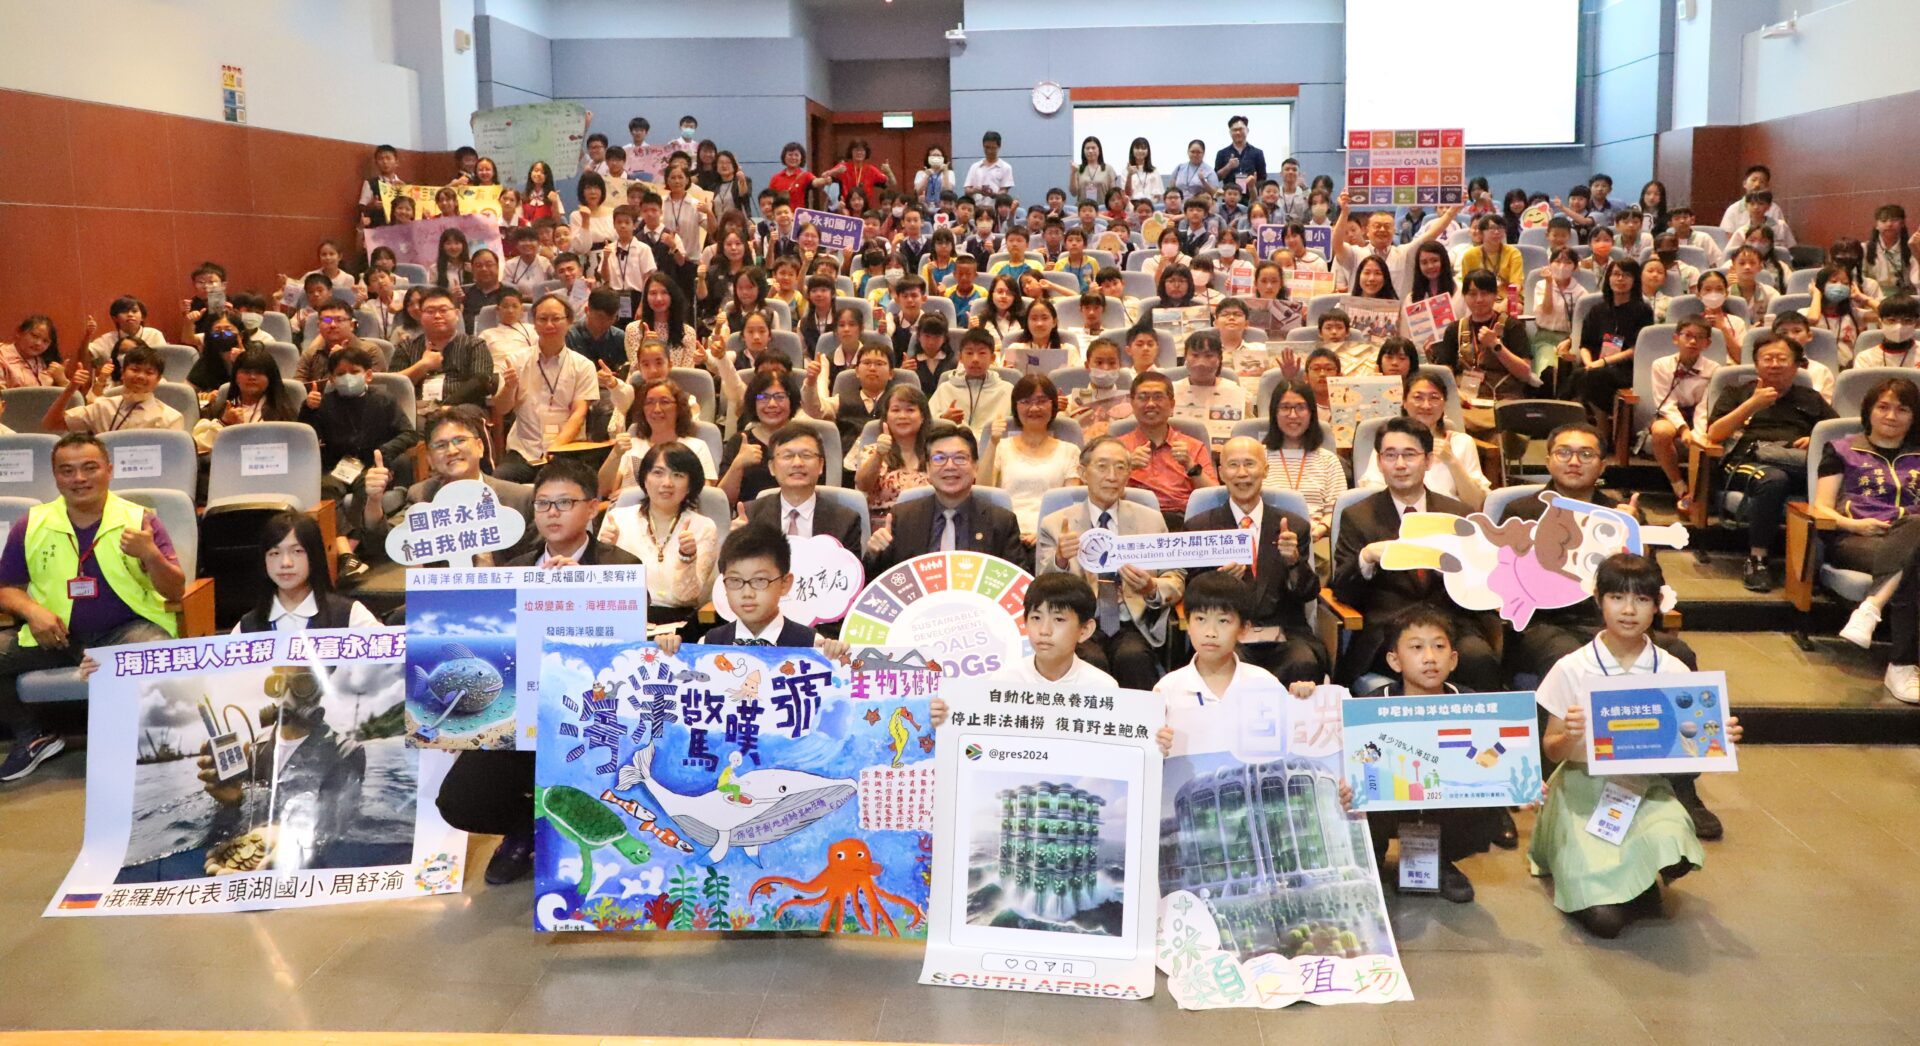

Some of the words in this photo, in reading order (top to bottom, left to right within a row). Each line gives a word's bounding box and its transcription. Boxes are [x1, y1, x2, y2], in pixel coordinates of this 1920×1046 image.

[1404, 158, 1438, 166] GOALS
[812, 214, 857, 232] 永和國小
[409, 500, 496, 532] 國際永續
[413, 526, 501, 558] 由我做起
[1117, 552, 1164, 560] Association
[1177, 548, 1209, 557] Foreign
[1212, 547, 1250, 555] Relations
[413, 572, 514, 585] AI海洋保育酷點子
[523, 570, 637, 584] 印度_成福國小_黎宥祥
[907, 592, 917, 600] 17
[888, 609, 898, 618] 16
[911, 610, 980, 632] SUSTAINABLE
[546, 626, 615, 637] 發明海洋吸塵器
[914, 621, 983, 642] DEVELOPMENT
[115, 638, 275, 676] 海洋與人共榮
[943, 654, 1001, 679] DGs
[850, 667, 942, 699] 生物多樣性
[989, 688, 1114, 711] 自動化鮑魚養殖場
[1377, 702, 1498, 718] 印尼對海洋垃圾的處理
[1600, 704, 1663, 717] 永續海洋生態
[951, 711, 1045, 730] 停止非法捕撈
[1055, 716, 1150, 740] 復育野生鮑魚
[988, 748, 1049, 761] @gres2024
[1426, 792, 1442, 800] 2025
[103, 882, 223, 909] 俄羅斯代表
[227, 874, 324, 902] 頭湖國小
[329, 869, 405, 896] 周舒渝
[931, 972, 1027, 990] SOUTH
[1034, 979, 1141, 997] AFRICA
